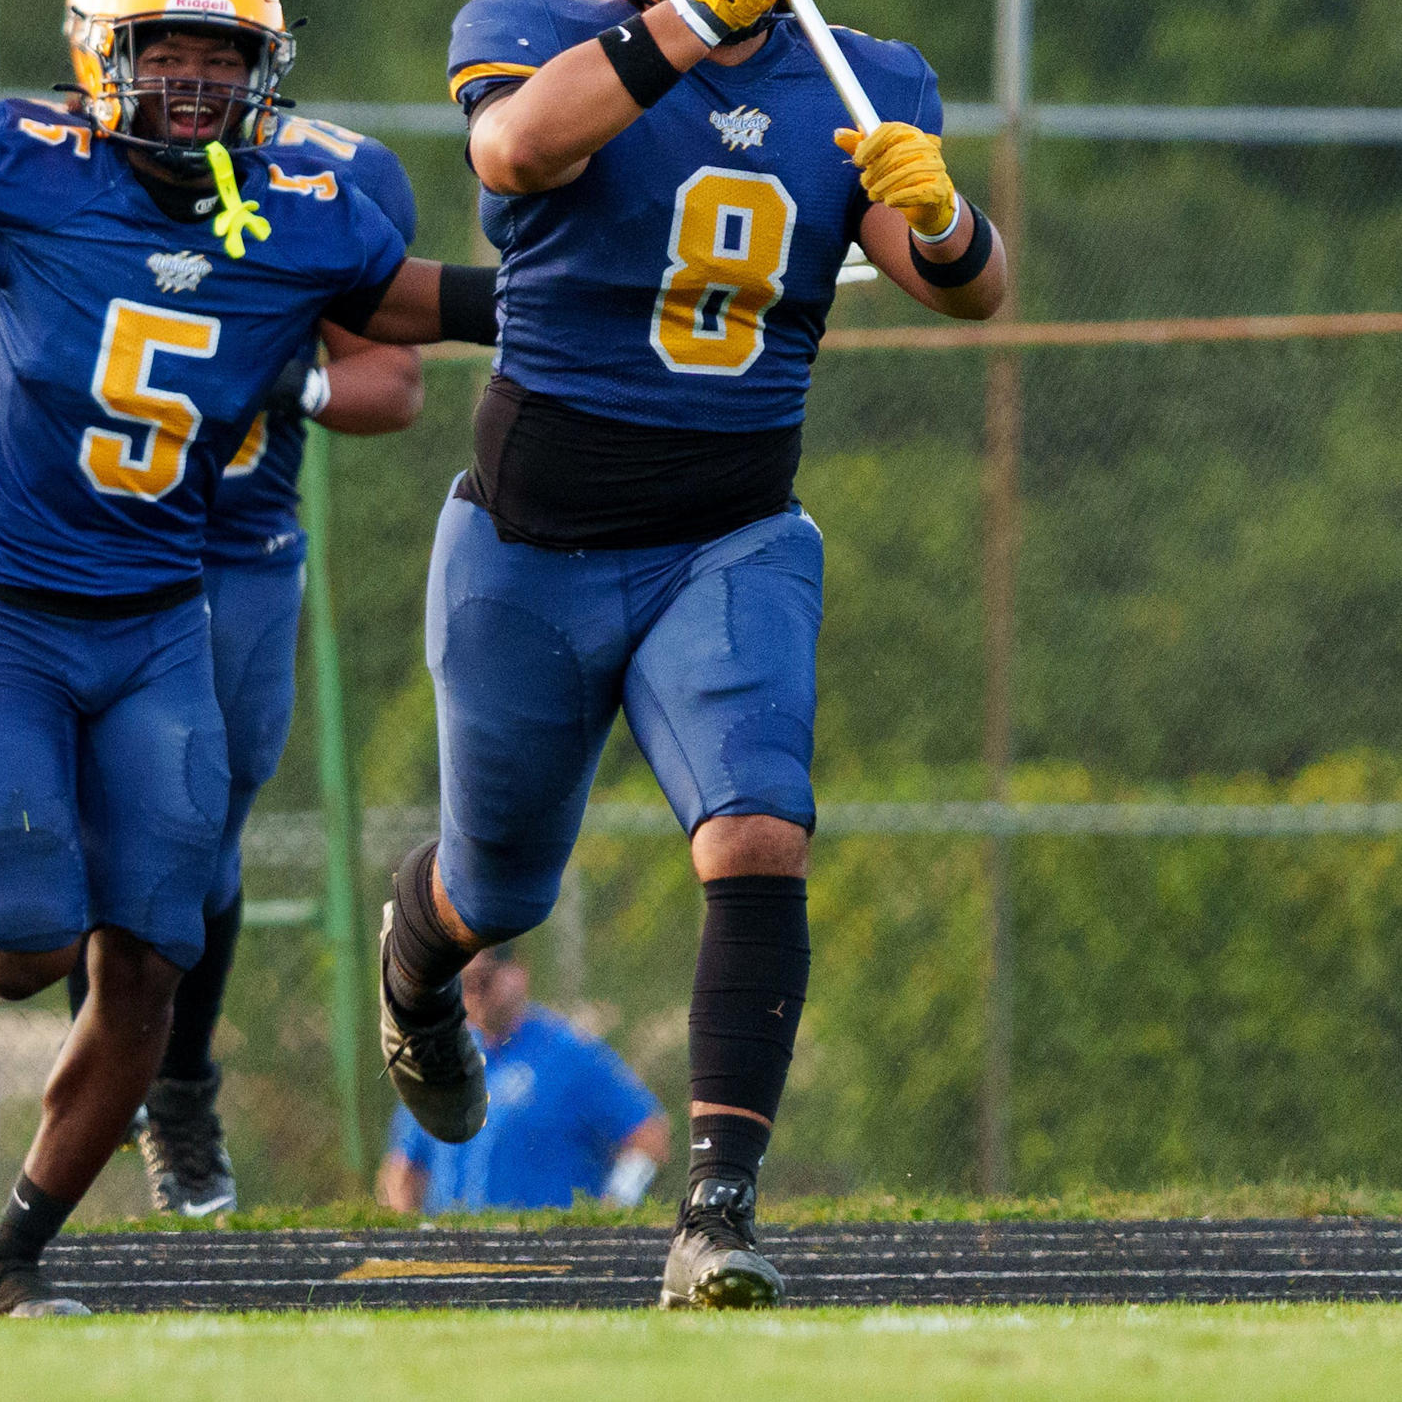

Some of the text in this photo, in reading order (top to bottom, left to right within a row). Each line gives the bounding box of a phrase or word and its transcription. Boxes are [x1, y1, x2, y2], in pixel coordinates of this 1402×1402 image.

[19, 117, 93, 161] 5
[648, 166, 797, 377] 8
[81, 298, 222, 502] 5
